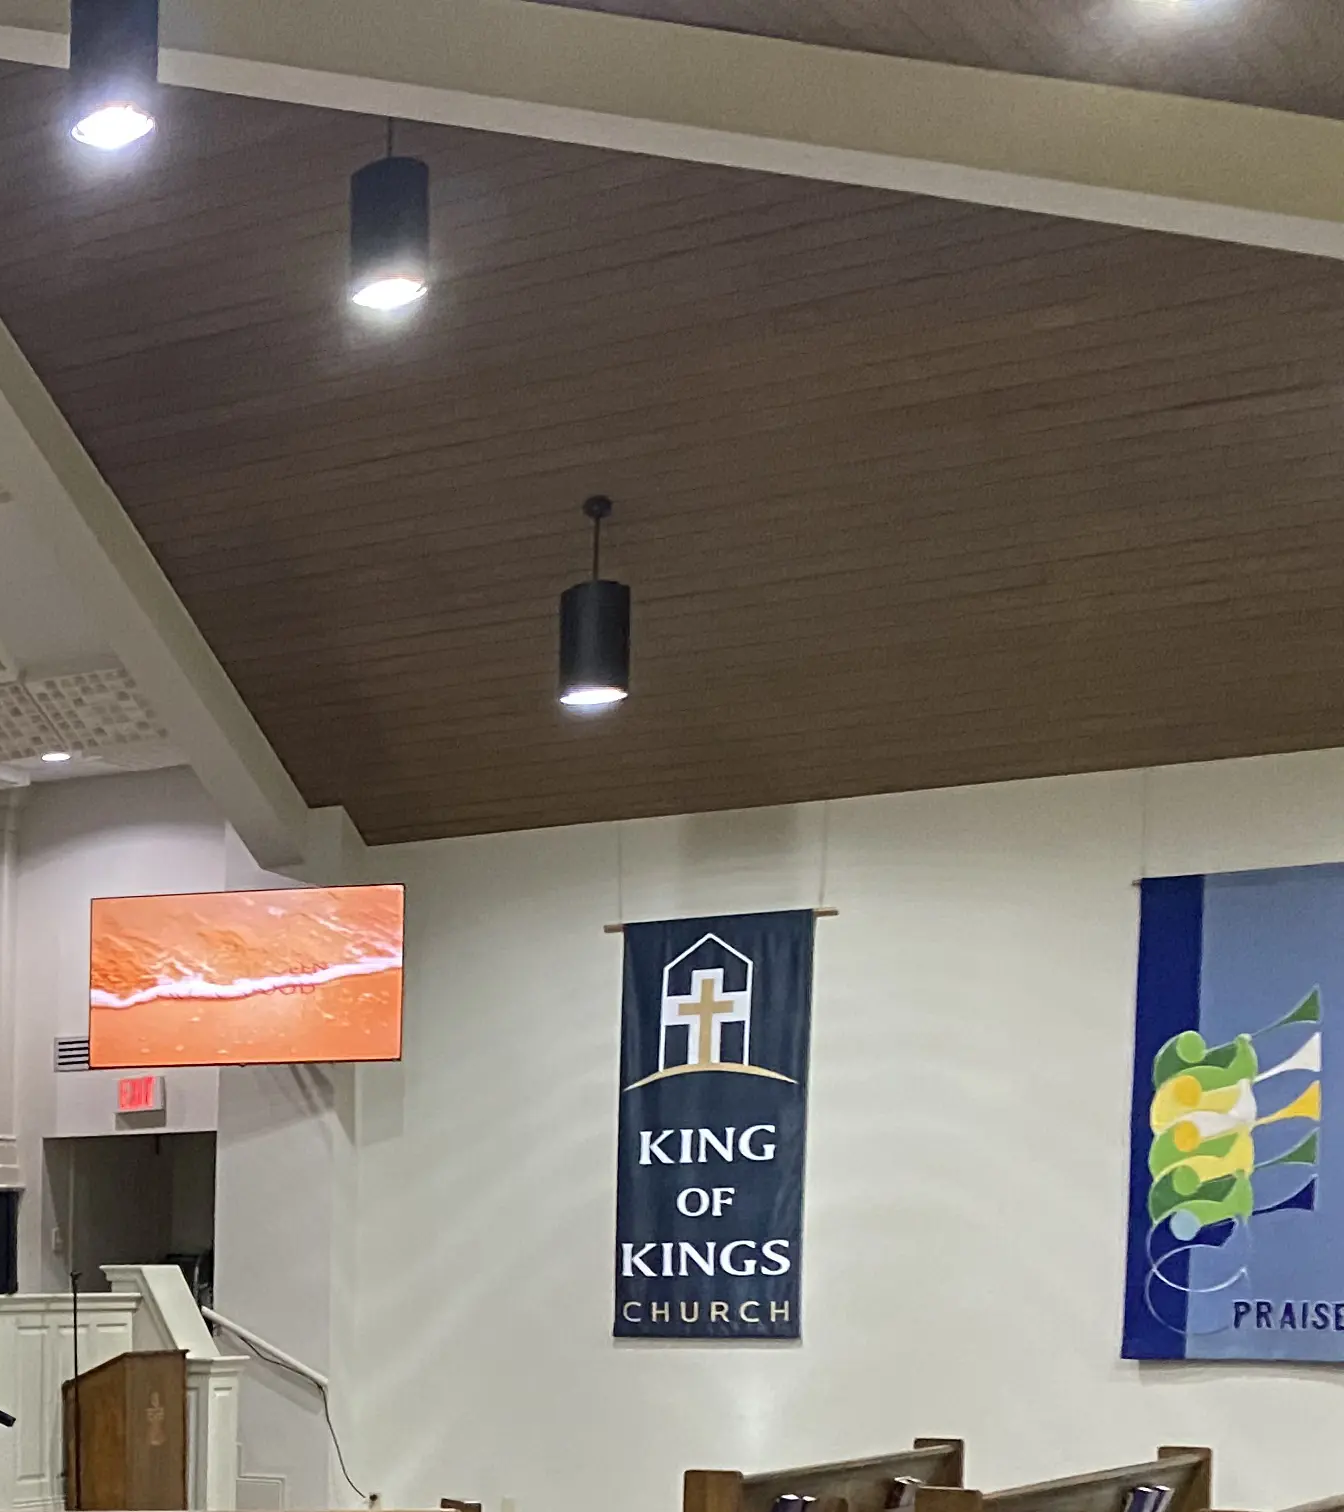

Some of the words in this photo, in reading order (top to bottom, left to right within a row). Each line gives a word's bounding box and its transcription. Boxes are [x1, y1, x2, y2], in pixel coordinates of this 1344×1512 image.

[639, 1124, 776, 1165] KING
[676, 1187, 735, 1218] OF
[620, 1239, 791, 1278] KINGS
[622, 1300, 791, 1323] CHURCH
